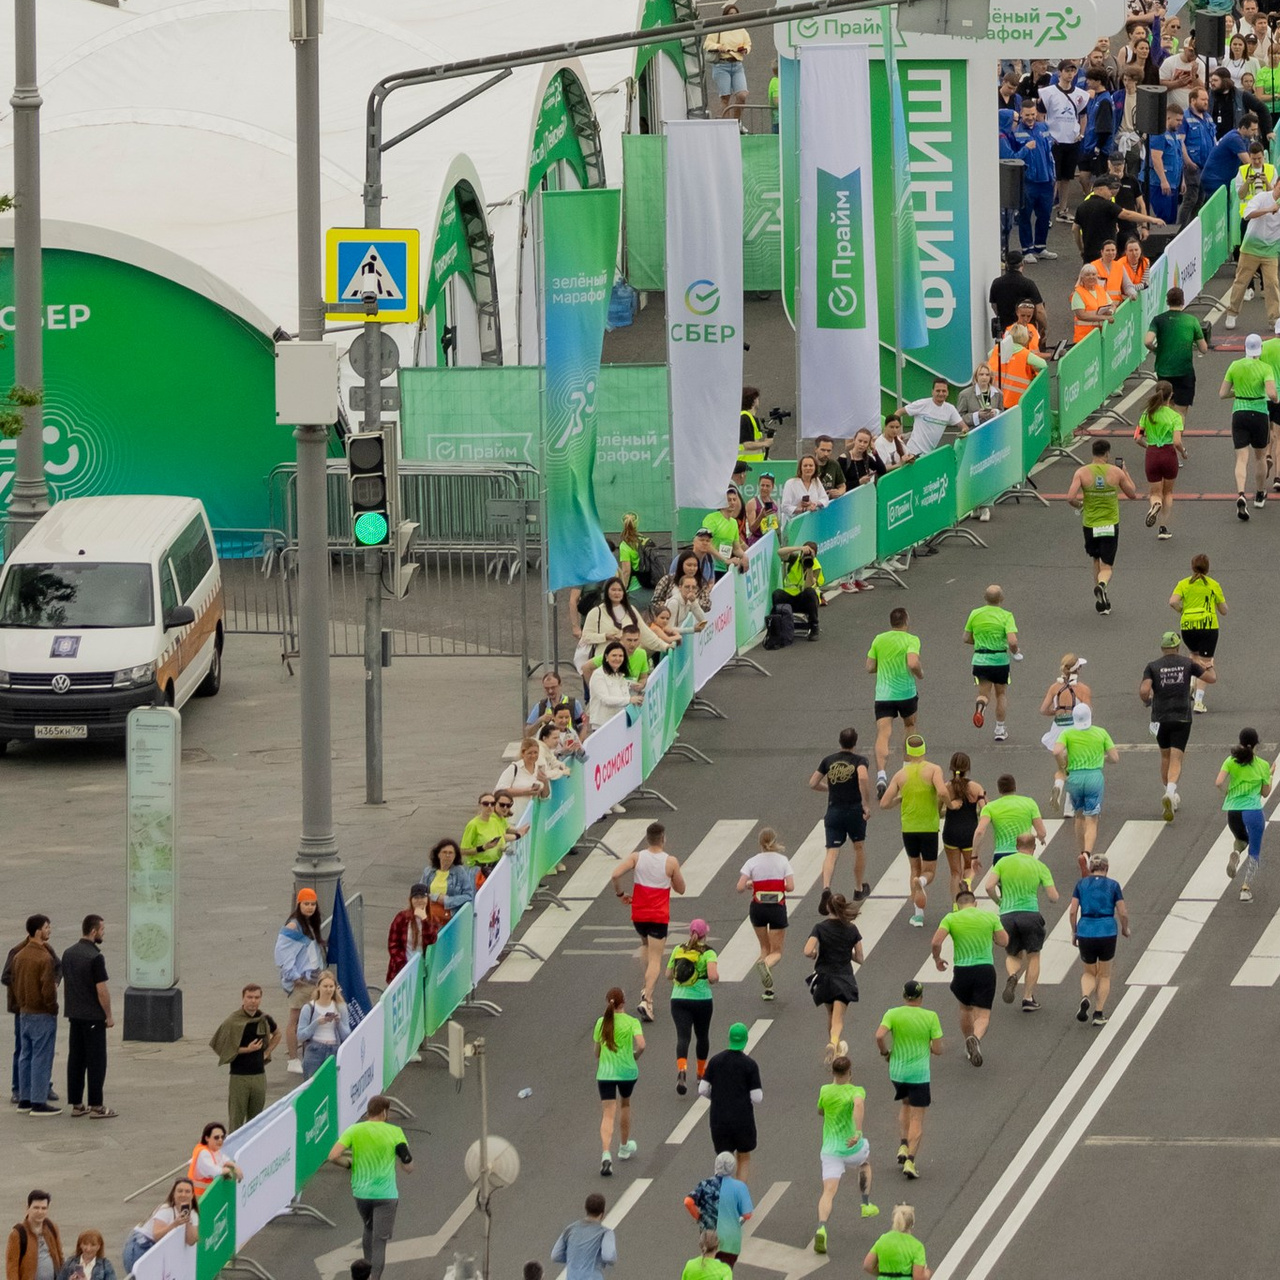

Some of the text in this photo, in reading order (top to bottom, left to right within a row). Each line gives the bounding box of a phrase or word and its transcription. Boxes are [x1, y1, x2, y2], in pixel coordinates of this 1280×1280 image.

[907, 68, 957, 330] ФИНИШ
[828, 190, 856, 280] Прайм
[0, 304, 91, 332] СЕР
[671, 323, 736, 344] СБЕР
[459, 442, 518, 462] Прайм
[596, 446, 651, 465] рафон
[745, 547, 768, 599] БЕГИ
[714, 605, 733, 635] МОБАЙЛ
